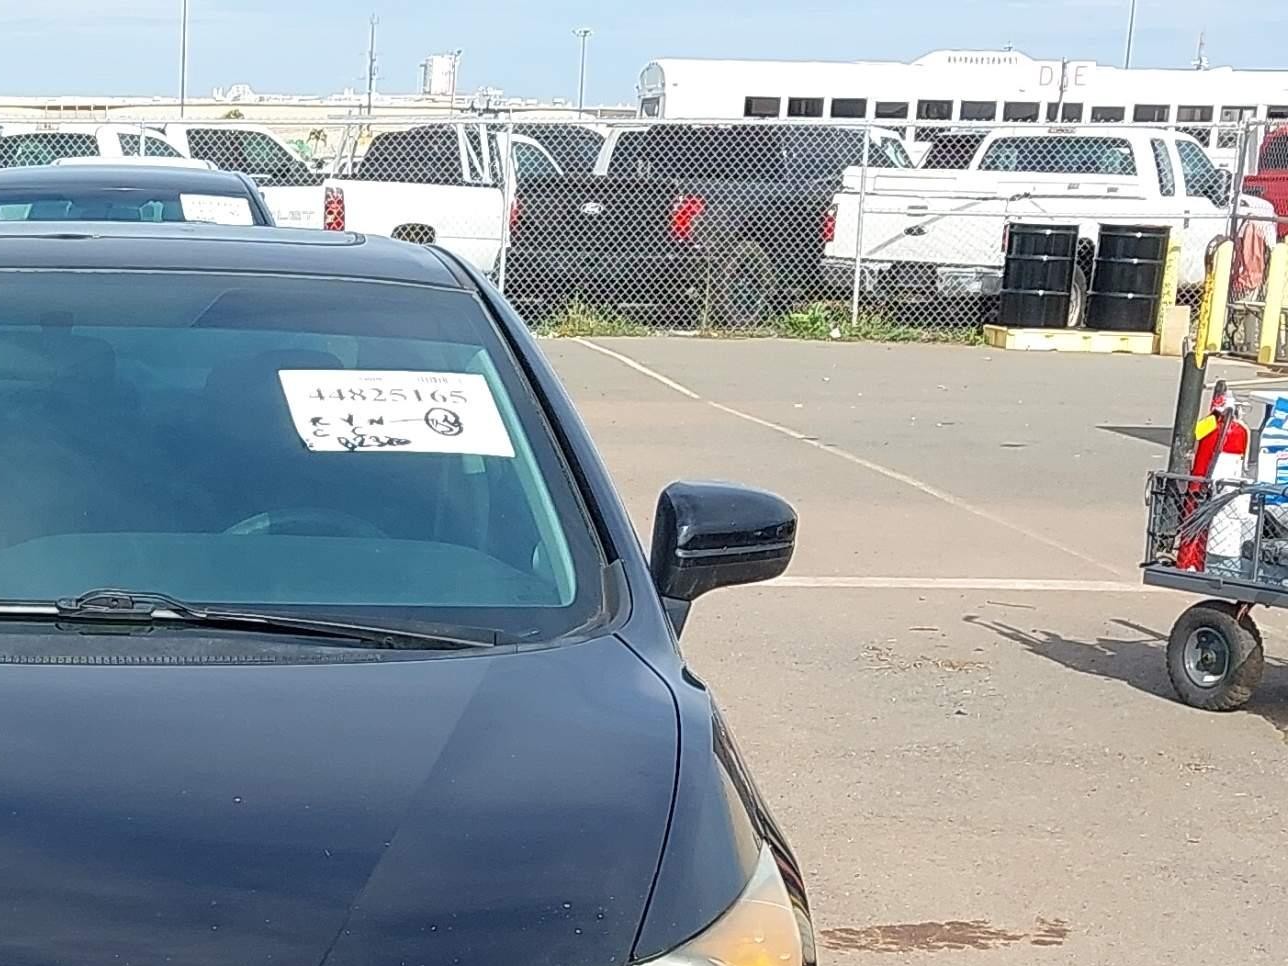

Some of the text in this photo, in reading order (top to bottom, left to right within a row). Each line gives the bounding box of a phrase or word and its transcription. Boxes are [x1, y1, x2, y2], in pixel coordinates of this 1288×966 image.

[1039, 65, 1054, 87] D
[1074, 65, 1089, 87] E
[309, 388, 469, 403] 44825165
